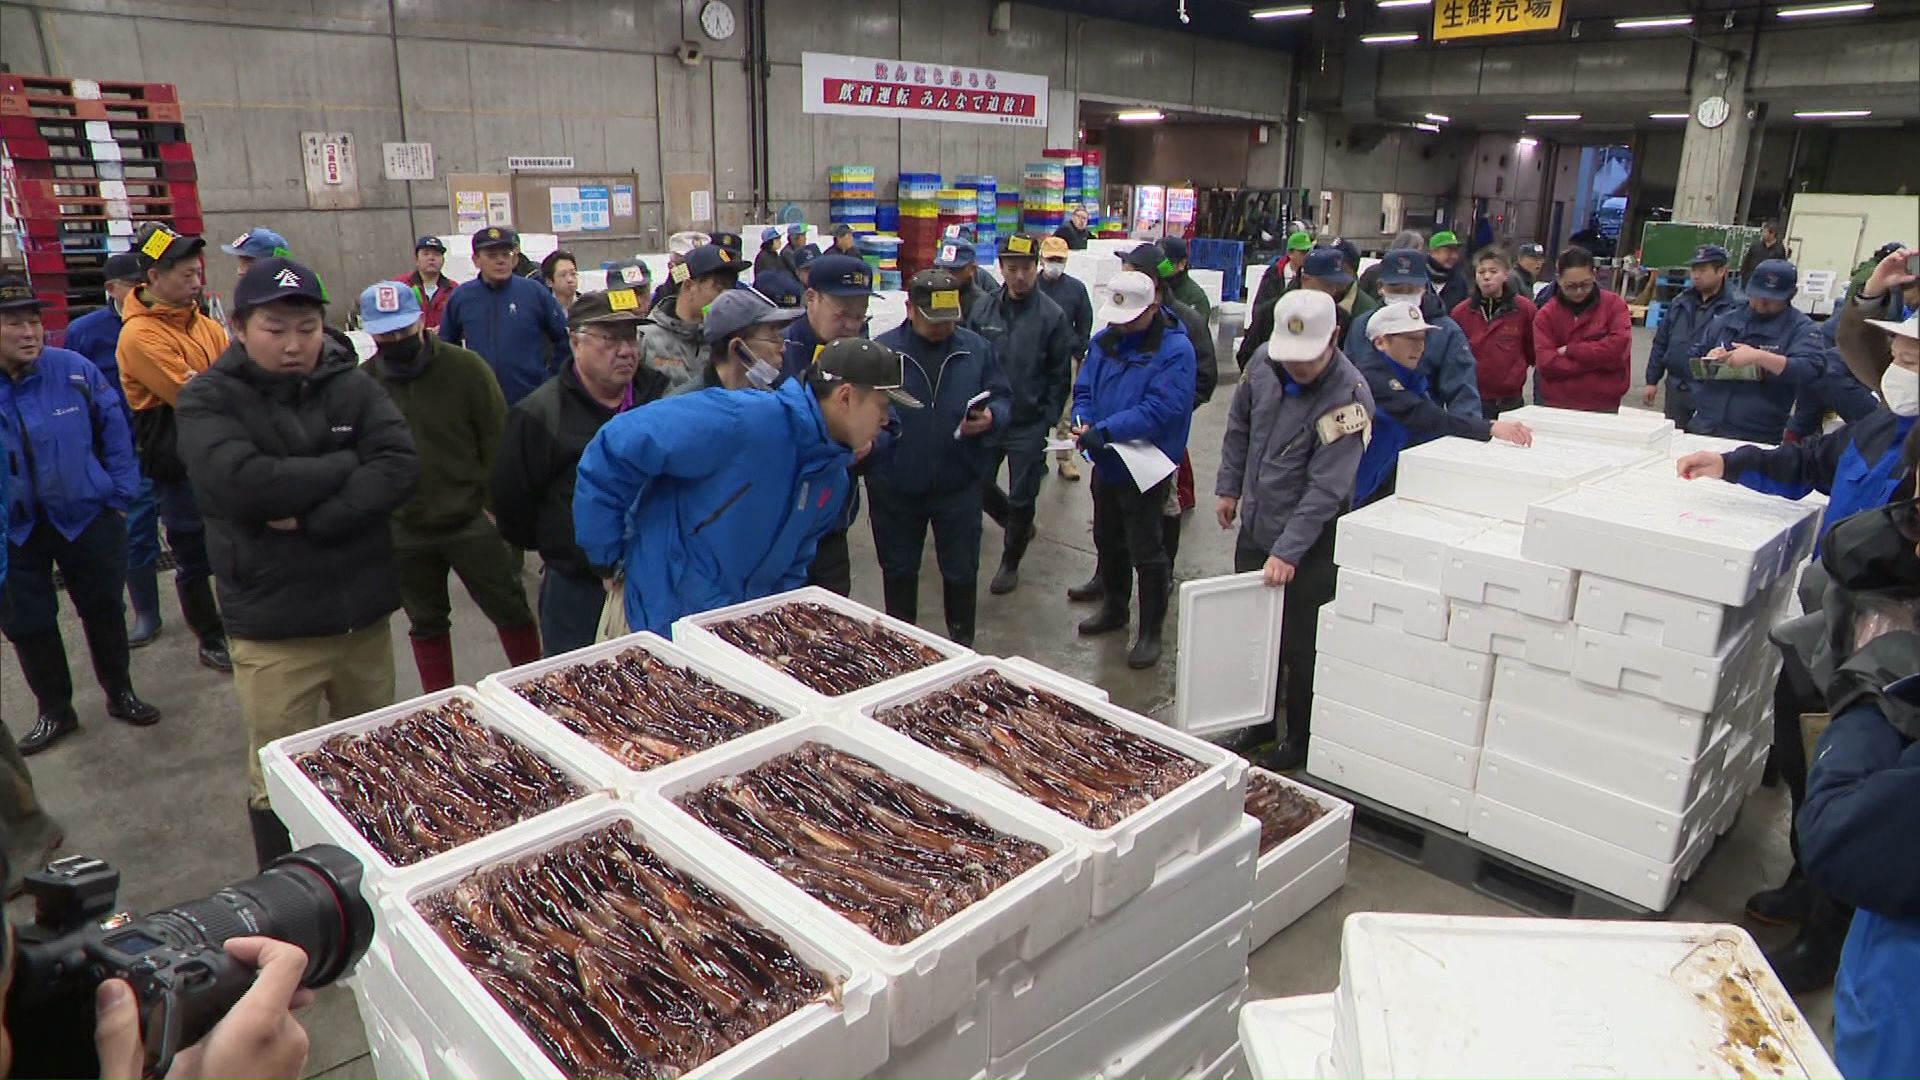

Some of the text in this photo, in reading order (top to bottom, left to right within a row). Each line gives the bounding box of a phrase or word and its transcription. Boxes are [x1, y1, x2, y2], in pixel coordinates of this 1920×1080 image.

[1442, 0, 1553, 29] 生鮮売場
[838, 82, 911, 106] 飲酒運転
